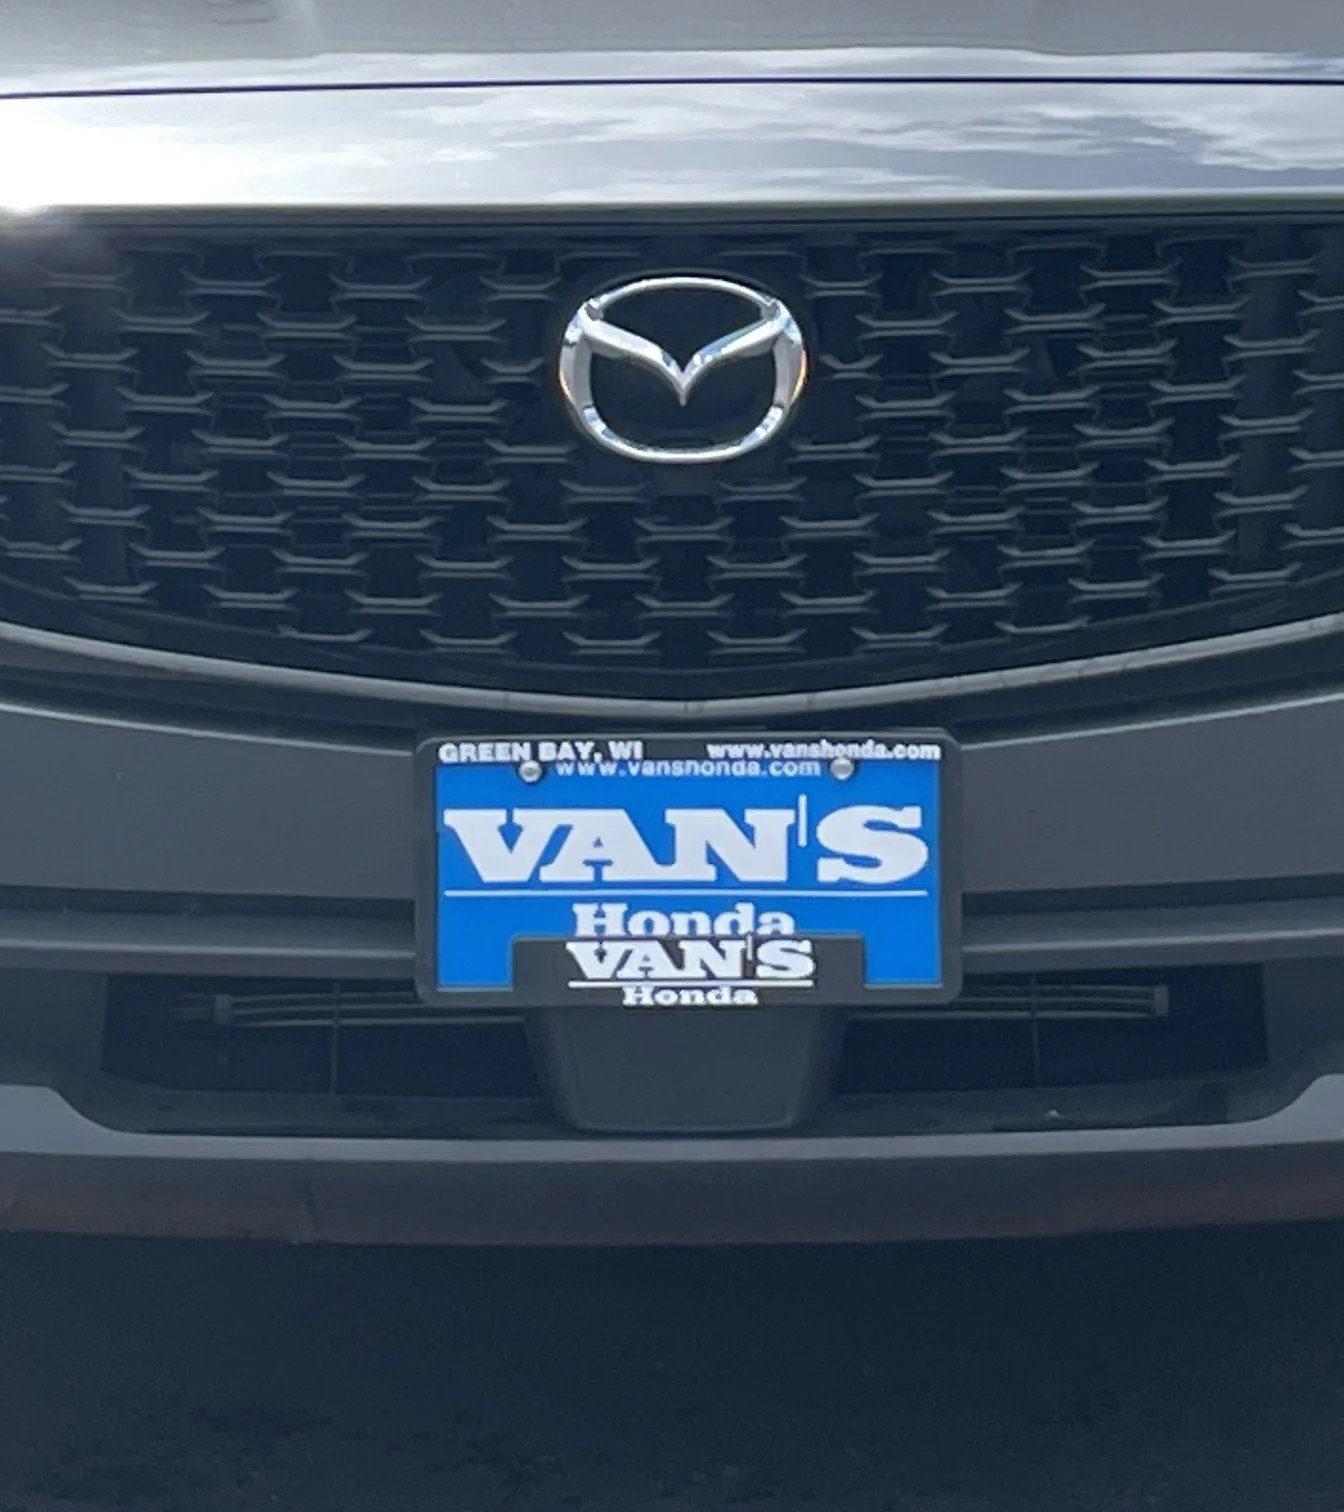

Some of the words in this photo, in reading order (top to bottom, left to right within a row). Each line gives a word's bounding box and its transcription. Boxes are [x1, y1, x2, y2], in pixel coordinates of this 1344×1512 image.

[438, 742, 531, 763] GREEN
[538, 742, 602, 764] BAY,
[609, 741, 643, 760] WI
[707, 739, 941, 761] www.vanshonda.com
[443, 794, 929, 884] VAN'S
[572, 902, 795, 936] Honda
[565, 934, 816, 979] VAN'S
[622, 986, 758, 1006] Honda
